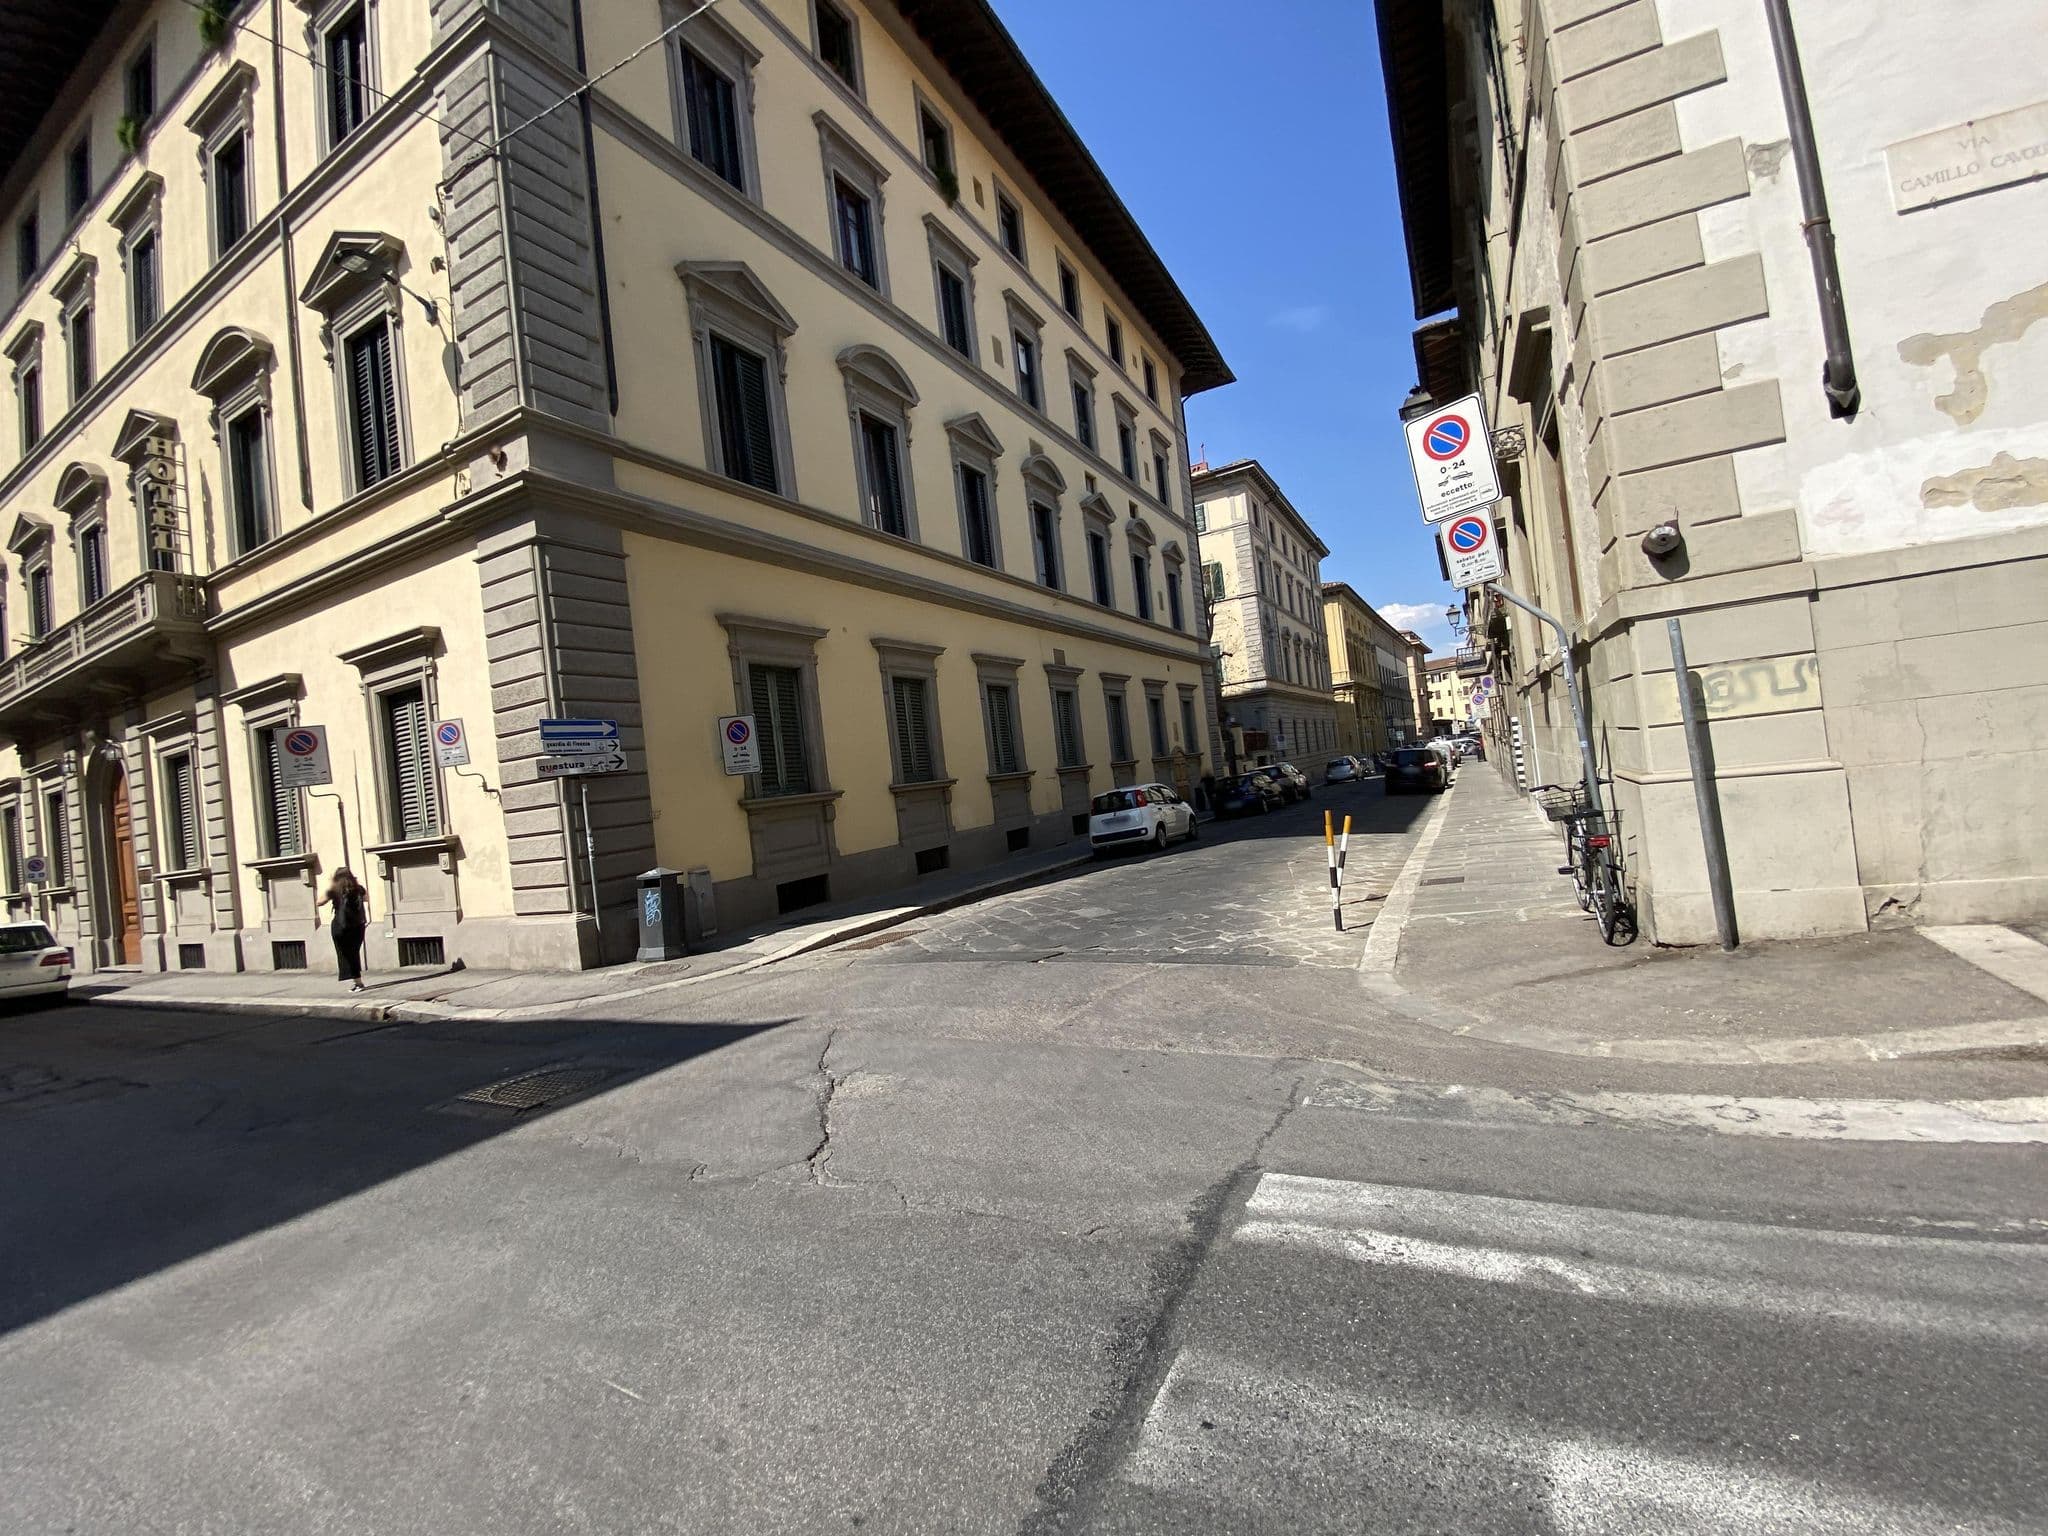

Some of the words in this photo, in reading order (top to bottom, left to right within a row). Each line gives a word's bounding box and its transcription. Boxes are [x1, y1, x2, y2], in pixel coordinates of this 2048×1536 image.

[1957, 134, 1991, 150] VIA
[1900, 161, 1981, 193] CAMILLO
[145, 435, 180, 553] HOTEL
[538, 761, 585, 772] questura
